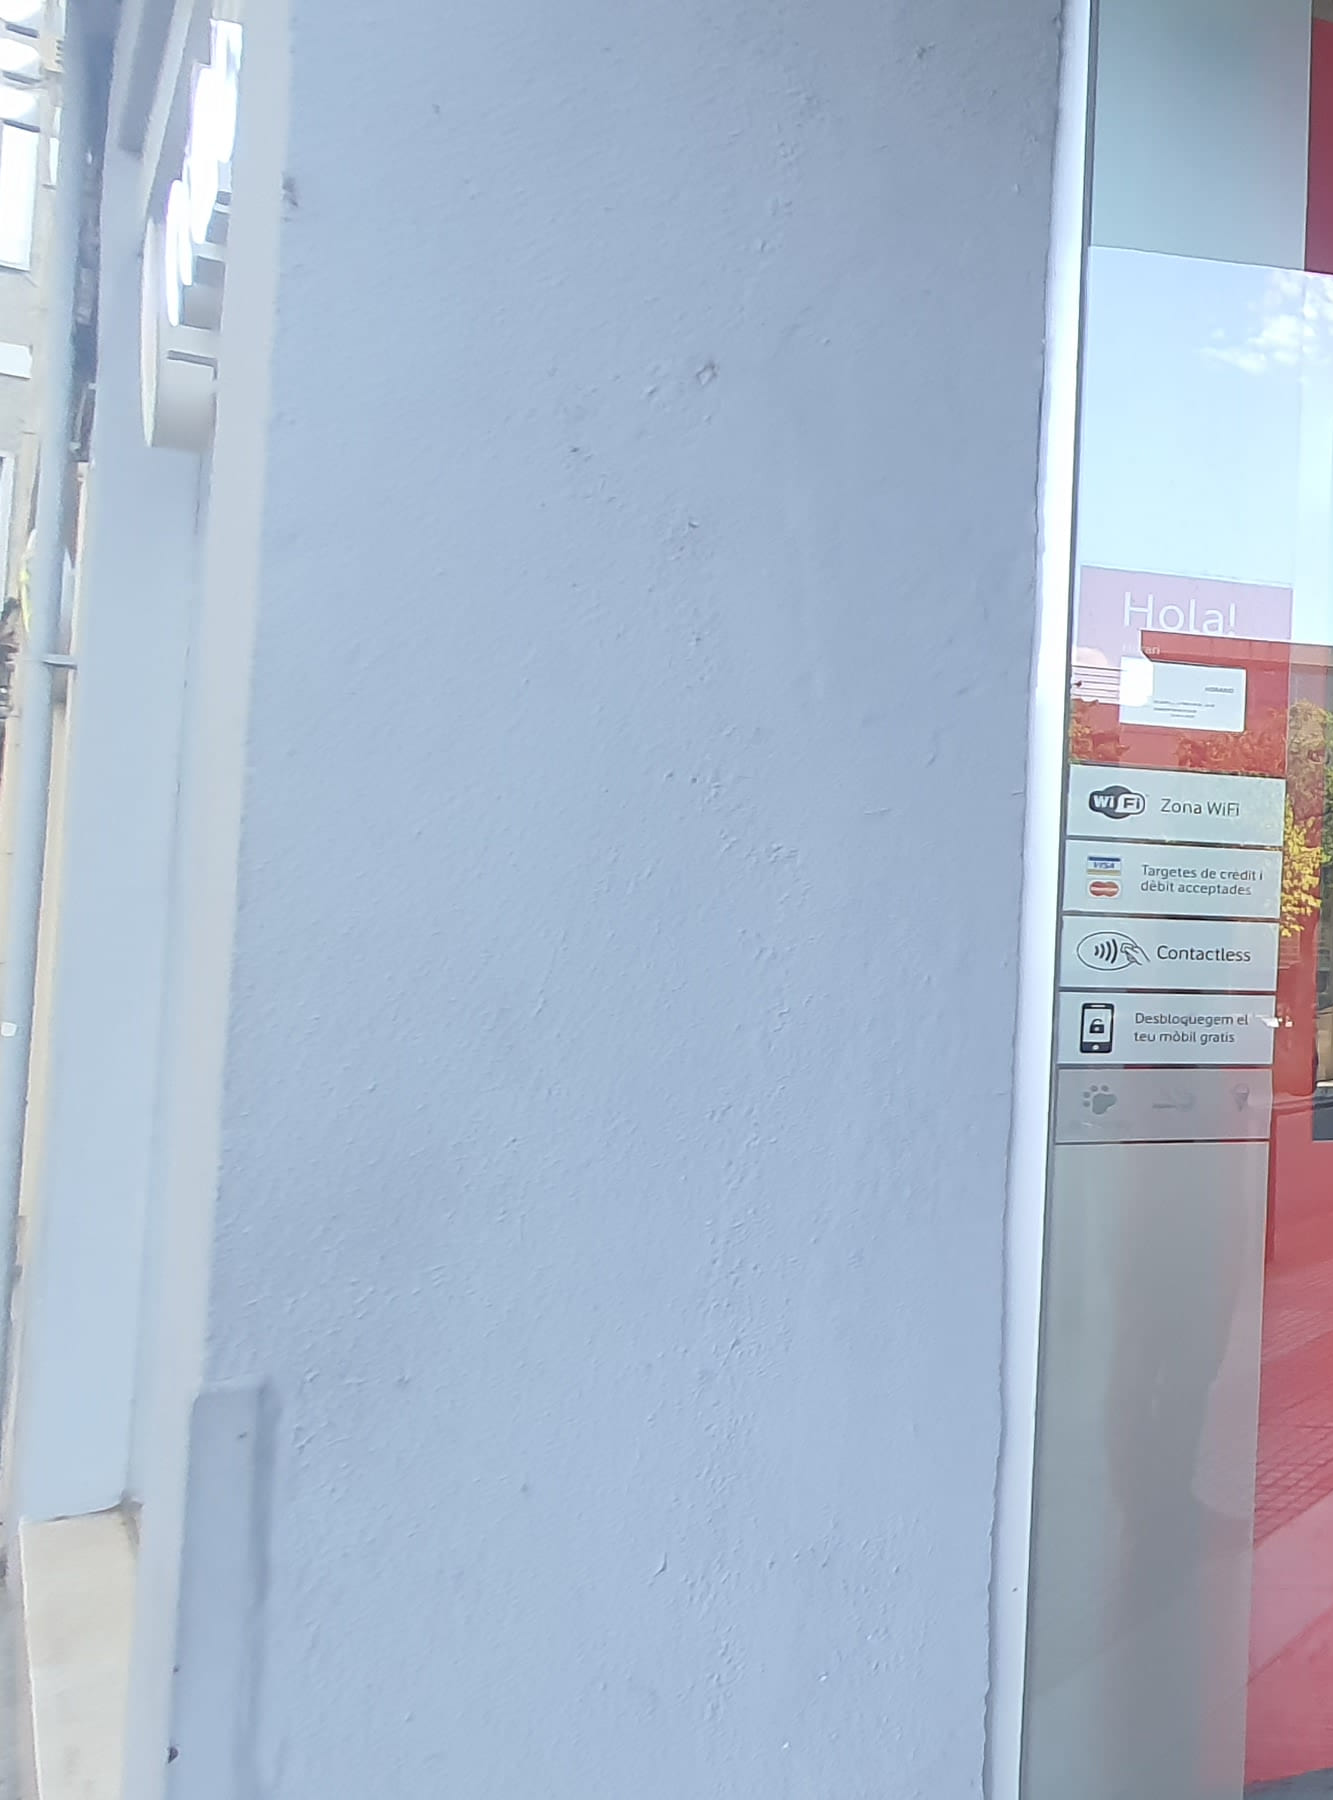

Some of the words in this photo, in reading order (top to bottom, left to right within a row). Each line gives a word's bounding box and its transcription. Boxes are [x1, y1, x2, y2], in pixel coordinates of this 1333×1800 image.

[1122, 590, 1237, 636] Hola!
[1160, 798, 1201, 814] Zona
[1206, 802, 1241, 817] WiFi
[1141, 865, 1197, 881] Targetes
[1200, 868, 1216, 880] de
[1177, 883, 1252, 897] acceptades
[1156, 945, 1252, 962] Contactless
[1135, 1012, 1234, 1028] Desbloquegem
[1236, 1014, 1249, 1026] el
[1134, 1032, 1157, 1042] teu
[1159, 1030, 1197, 1043] mòbil
[1200, 1033, 1235, 1046] gratis
